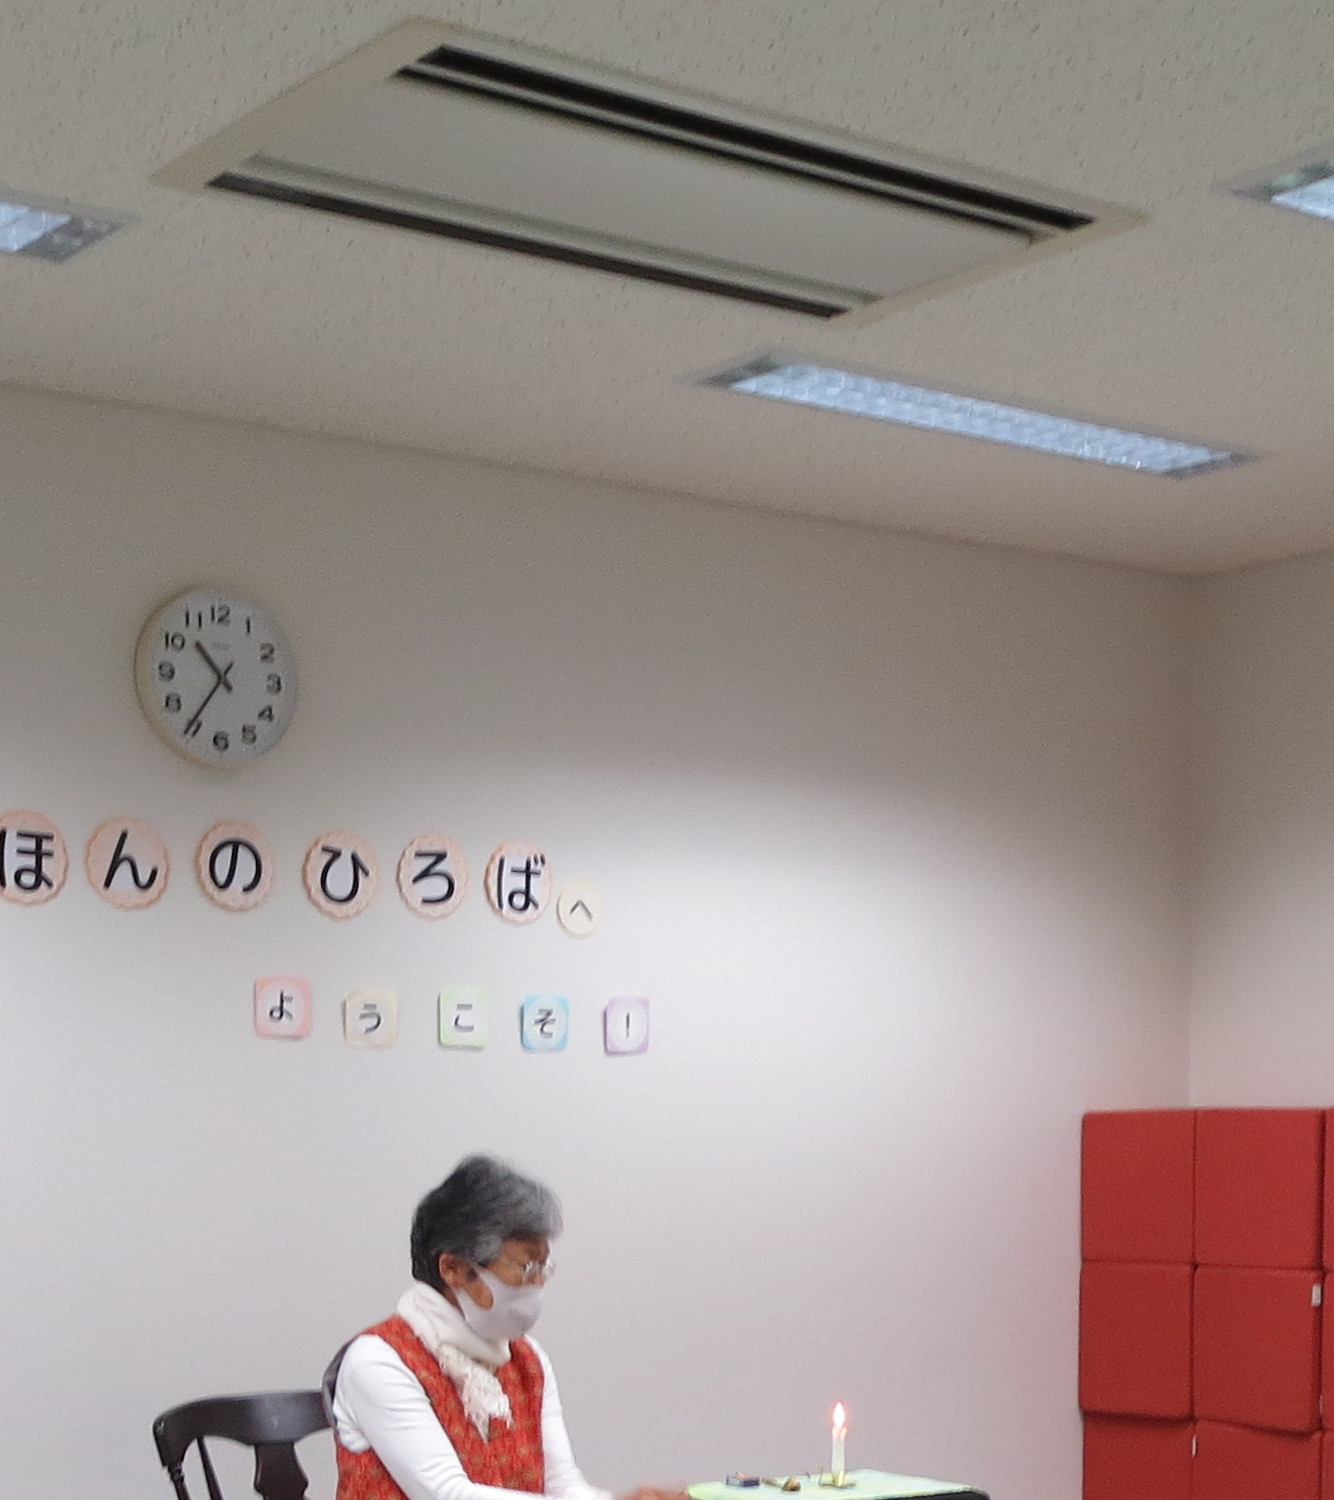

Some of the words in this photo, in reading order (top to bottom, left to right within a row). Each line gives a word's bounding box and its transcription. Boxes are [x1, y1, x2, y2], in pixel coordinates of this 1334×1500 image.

[185, 608, 202, 629] 11
[210, 604, 230, 626] 12
[245, 616, 252, 634] 1
[165, 632, 185, 651] 10
[259, 643, 274, 662] 2
[158, 661, 175, 681] 9
[267, 673, 281, 695] 3
[165, 692, 181, 713] 8
[257, 706, 274, 722] 4
[213, 731, 229, 751] 6
[242, 723, 257, 745] 5
